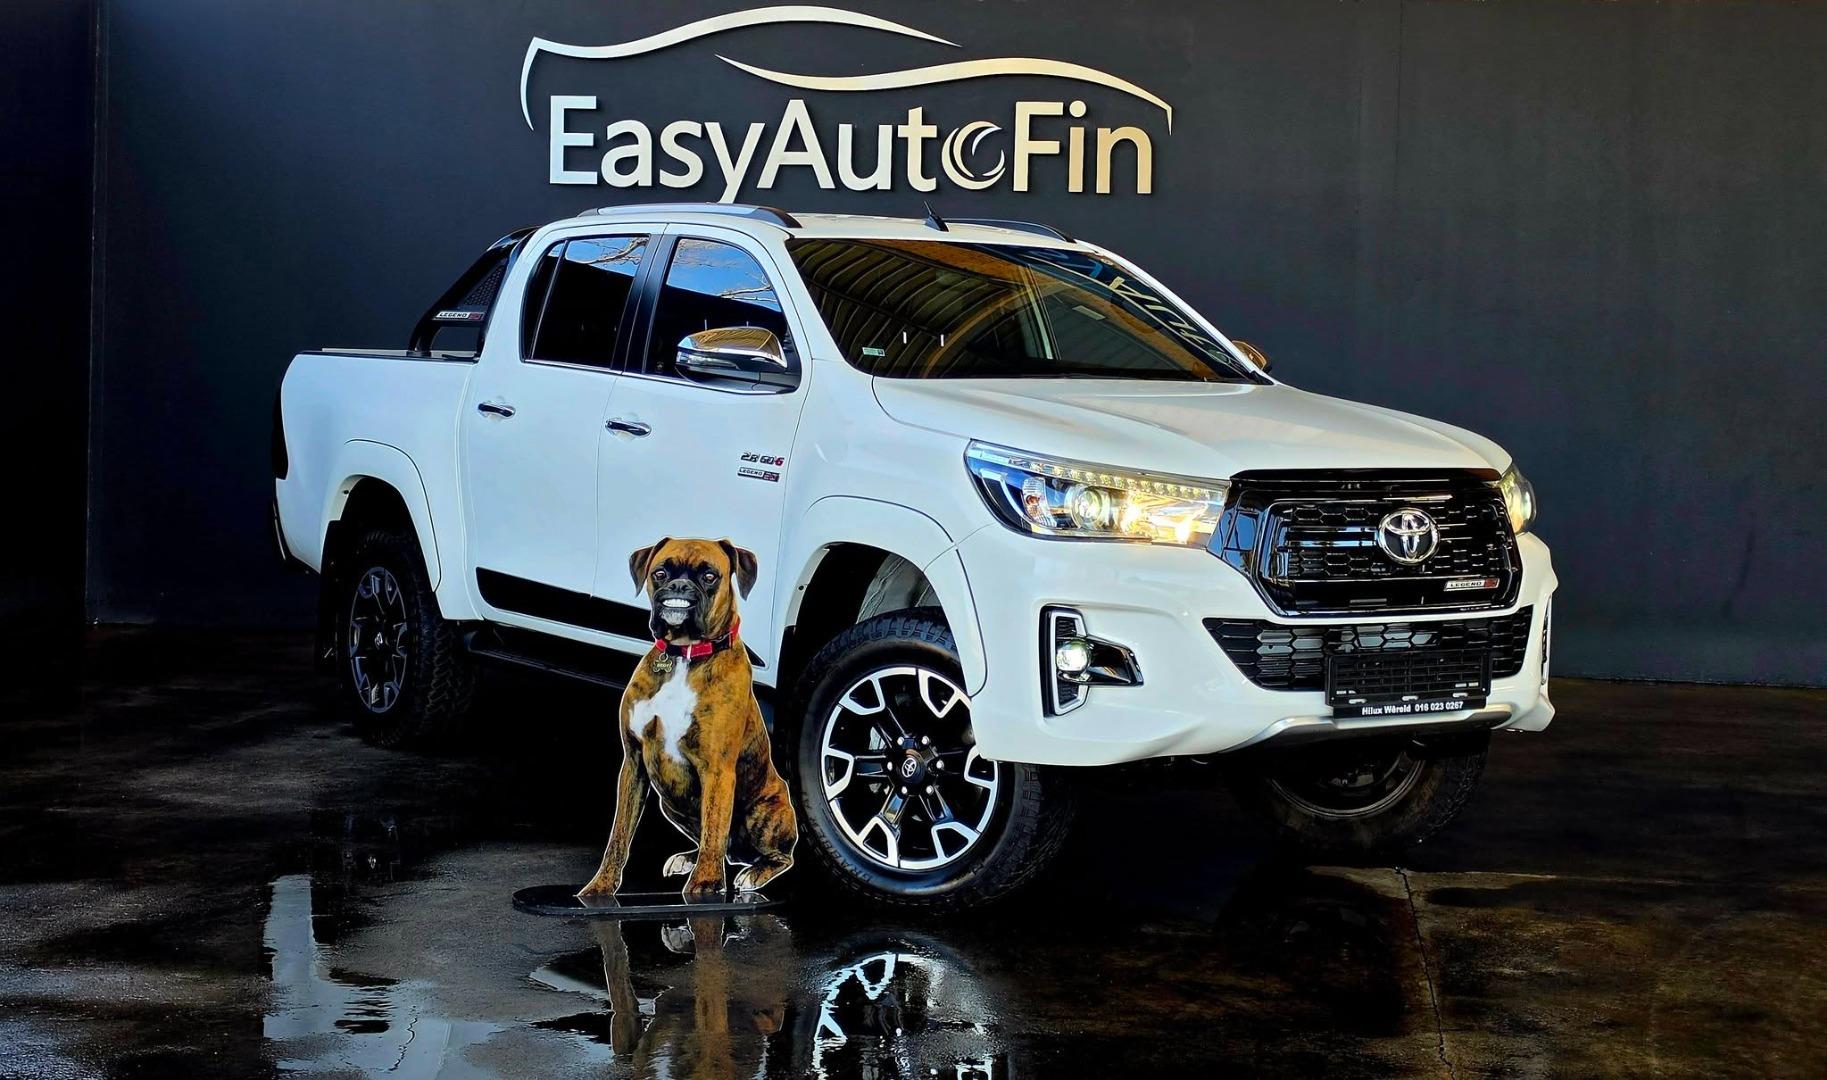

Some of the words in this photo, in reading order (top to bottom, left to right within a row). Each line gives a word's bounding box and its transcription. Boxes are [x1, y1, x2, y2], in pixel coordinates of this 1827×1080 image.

[549, 95, 1153, 204] EasyAutoFin
[1362, 706, 1382, 715] Hilux
[1430, 702, 1444, 711] 023
